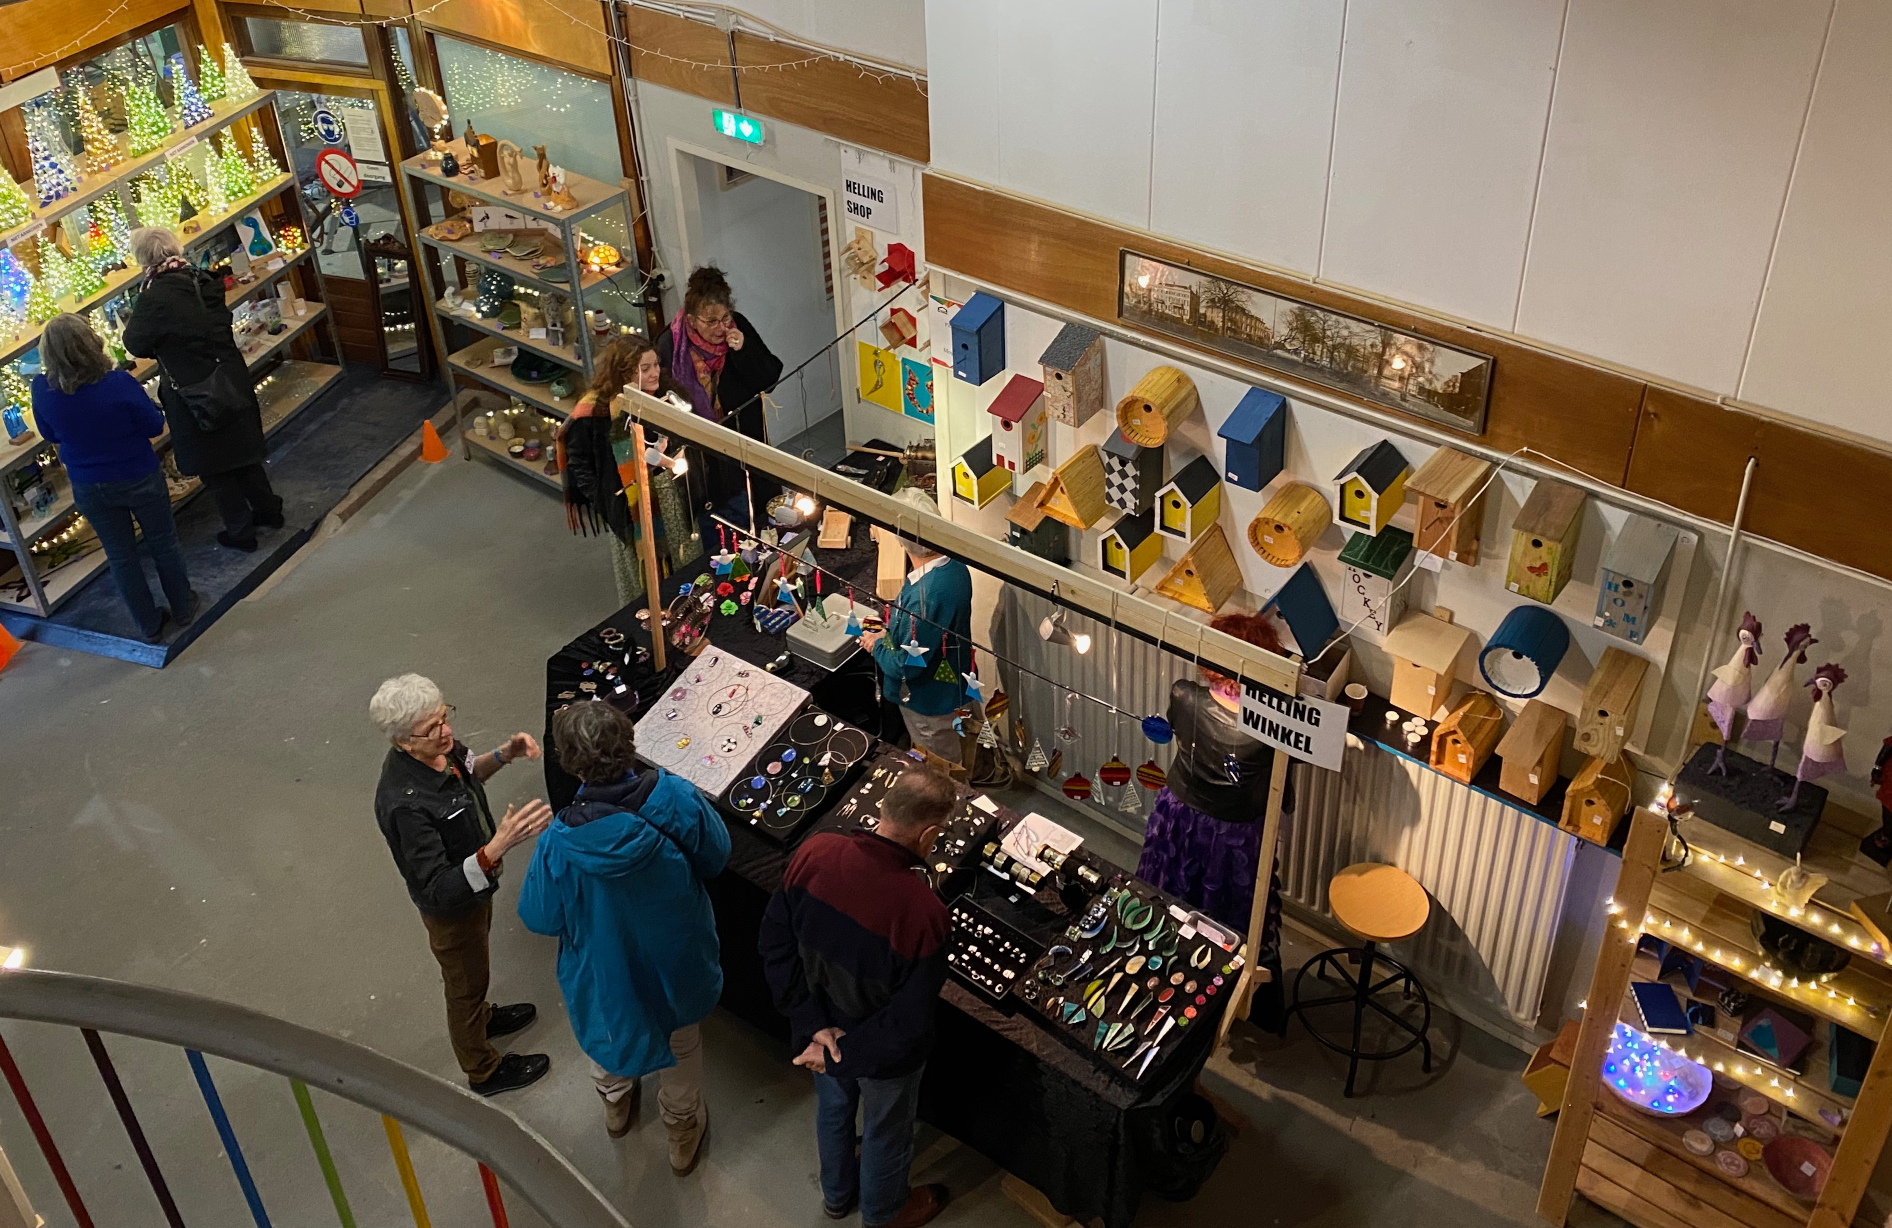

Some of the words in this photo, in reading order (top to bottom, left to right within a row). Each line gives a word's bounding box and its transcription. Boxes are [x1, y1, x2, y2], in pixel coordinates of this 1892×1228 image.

[845, 179, 884, 204] HELLING
[846, 199, 872, 220] SHOP
[1241, 706, 1314, 755] WINKEL
